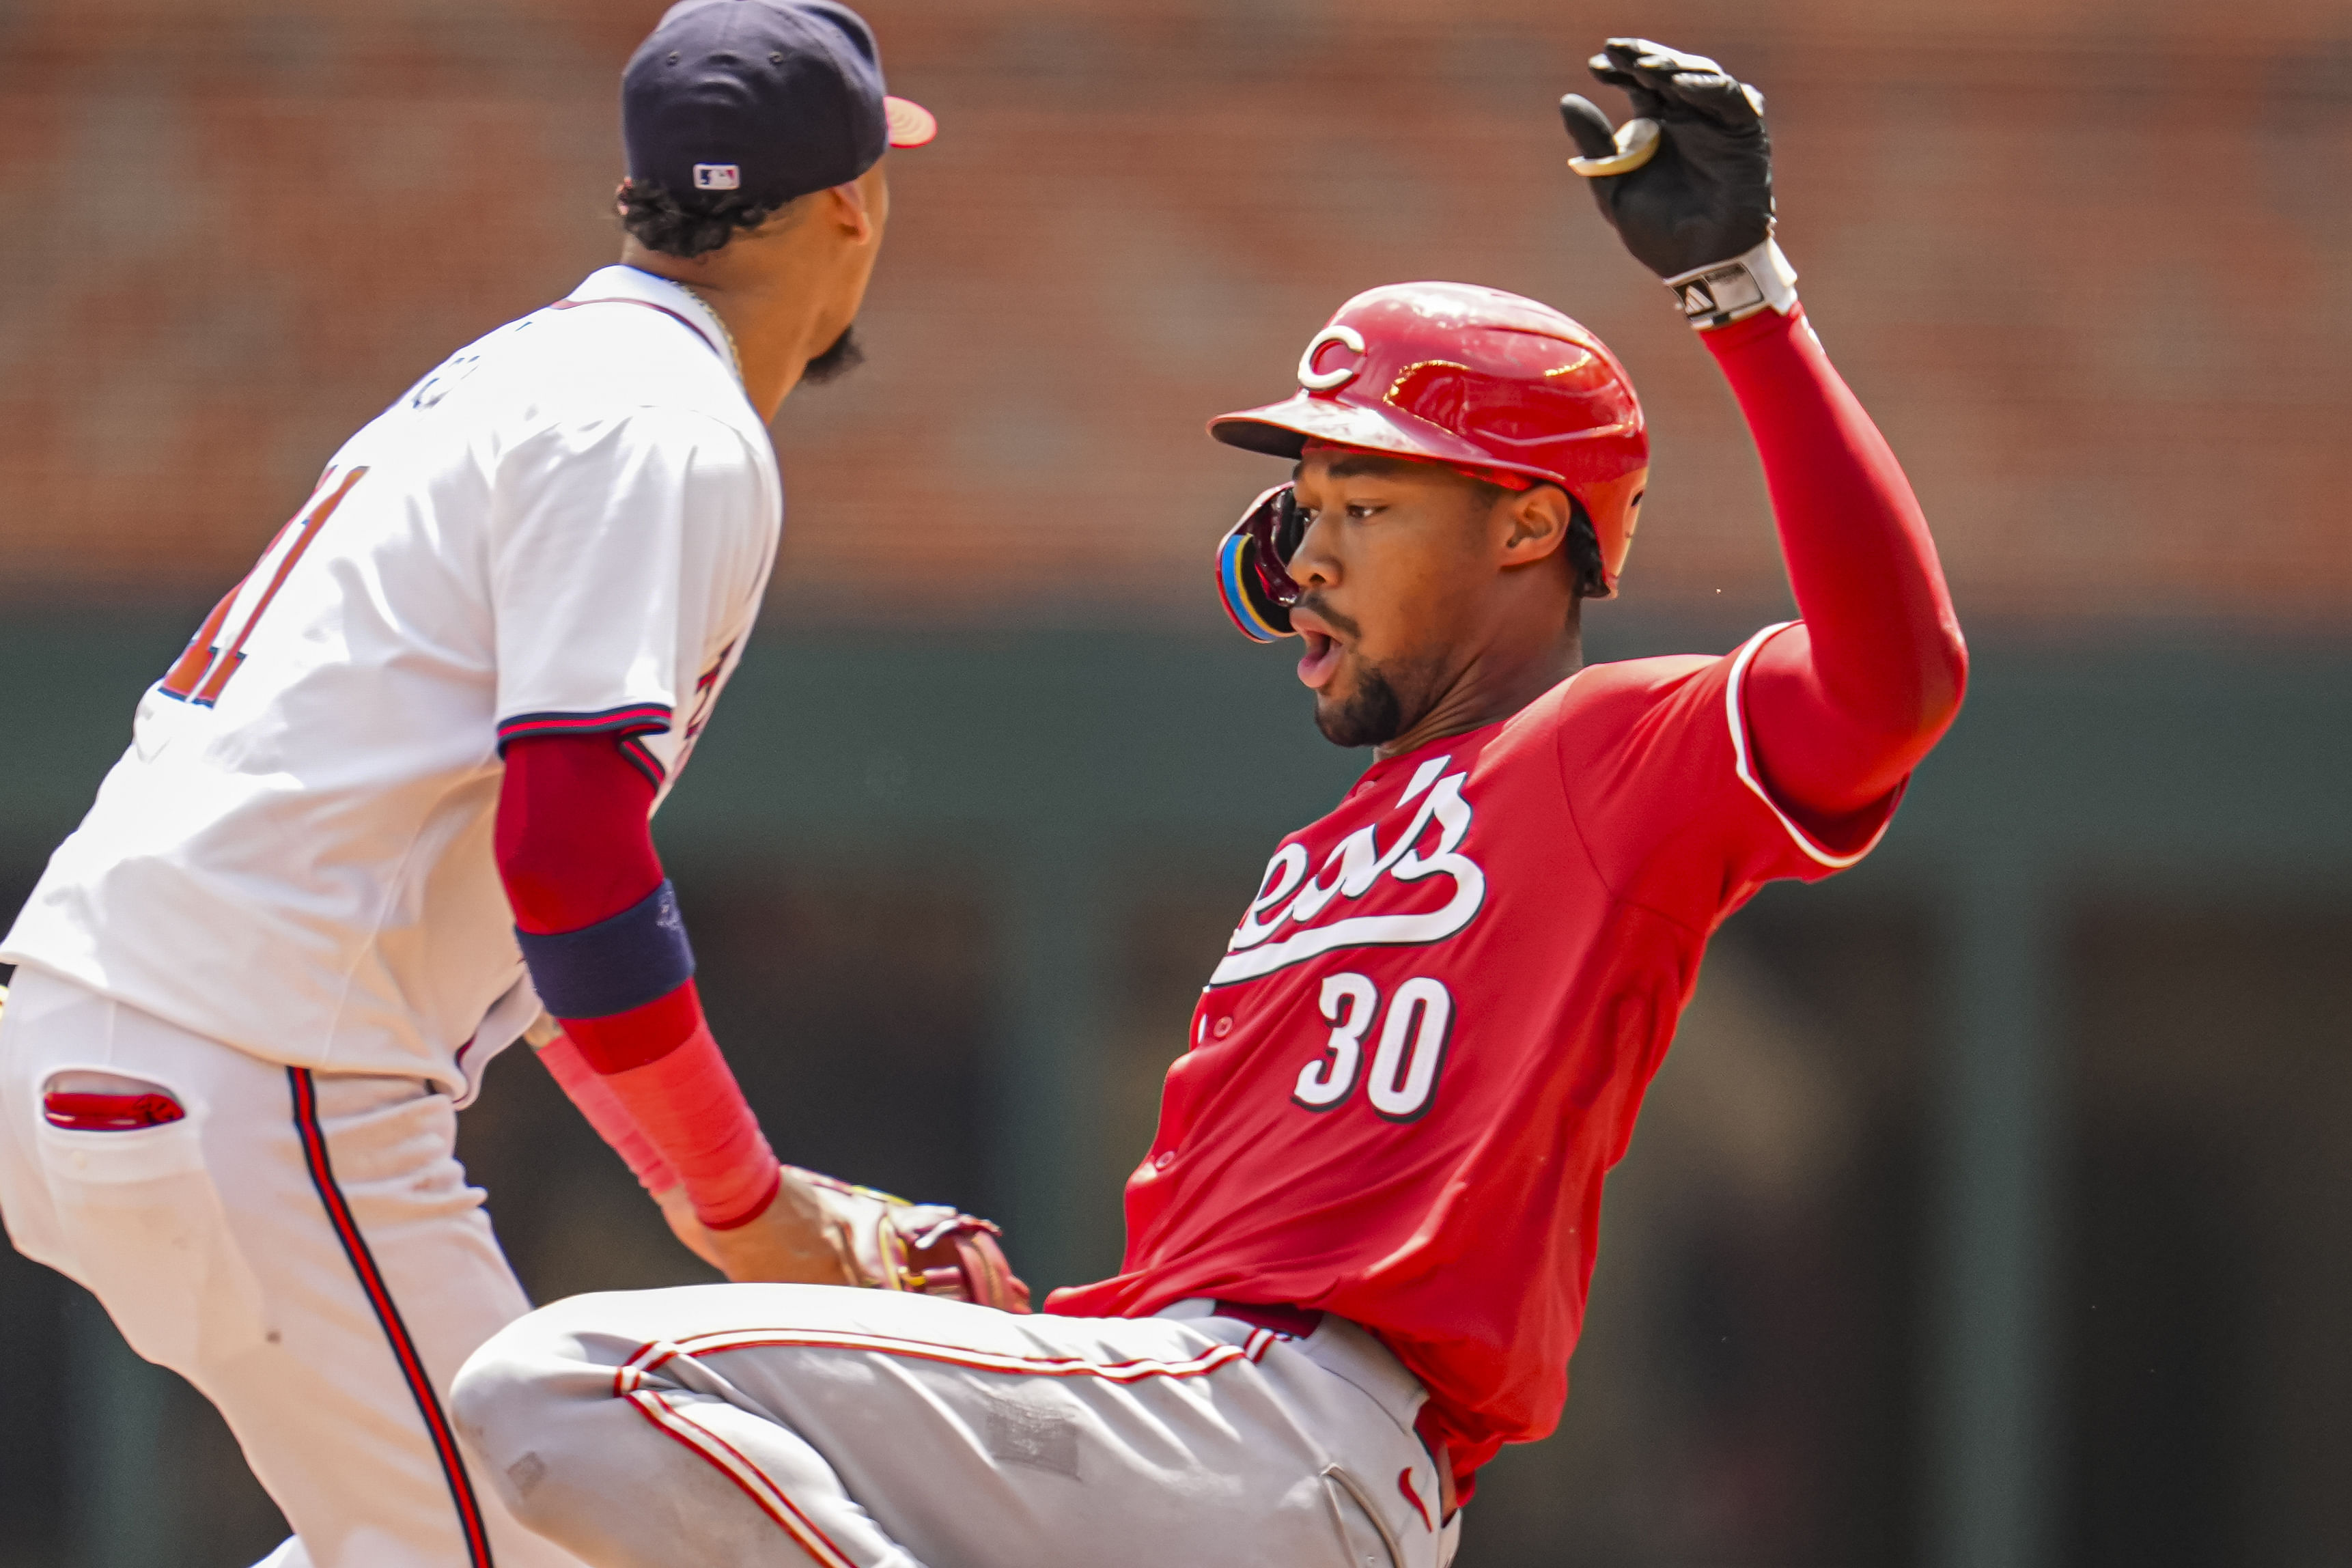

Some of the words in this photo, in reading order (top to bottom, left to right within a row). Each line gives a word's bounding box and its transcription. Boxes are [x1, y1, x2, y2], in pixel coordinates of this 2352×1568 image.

[1297, 324, 1366, 391] C
[1206, 754, 1486, 988] eds
[1289, 971, 1456, 1124] 30
